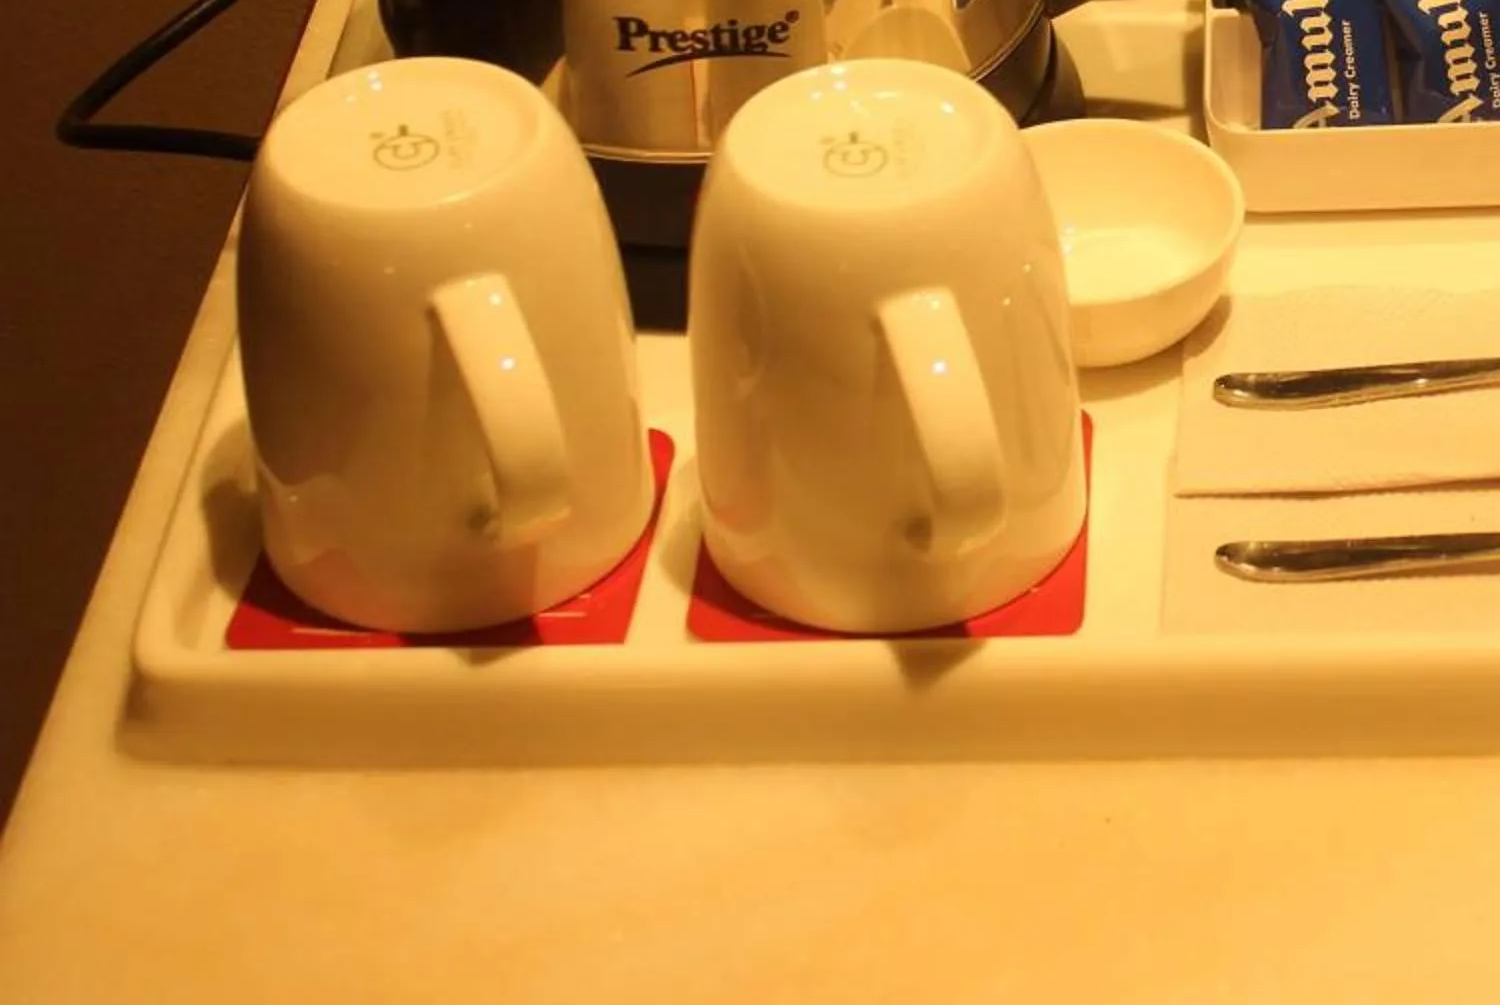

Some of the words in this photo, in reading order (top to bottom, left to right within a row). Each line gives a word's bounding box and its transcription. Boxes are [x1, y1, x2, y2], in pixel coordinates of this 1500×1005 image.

[612, 16, 791, 53] Prestige
[1341, 20, 1357, 79] Creamer
[1479, 12, 1497, 70] Creamer
[1348, 82, 1360, 120] Dairy
